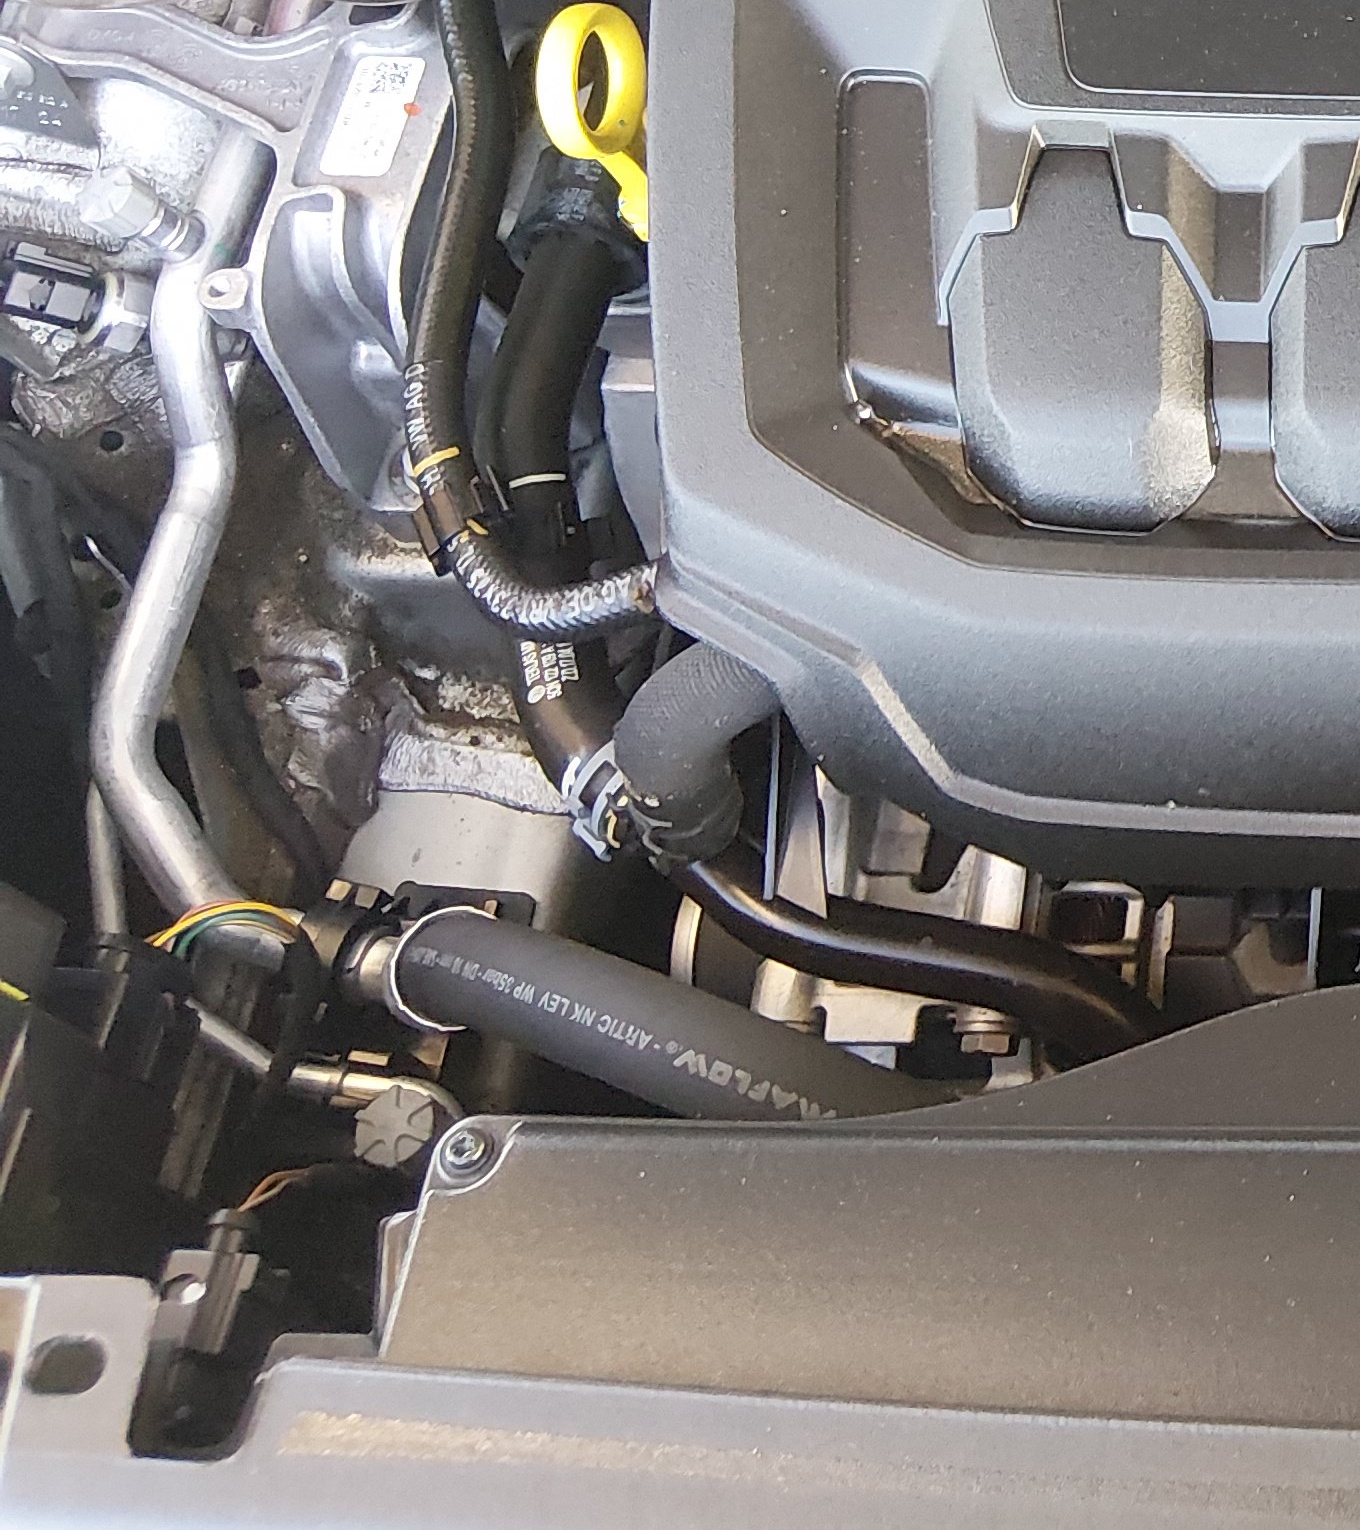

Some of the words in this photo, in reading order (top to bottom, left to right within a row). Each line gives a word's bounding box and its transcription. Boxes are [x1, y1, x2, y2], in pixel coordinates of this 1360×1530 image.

[403, 381, 423, 409] AG
[511, 980, 534, 1003] WP
[536, 990, 570, 1016] LEV
[568, 1002, 596, 1025] NK
[599, 1012, 653, 1049] ARTIC
